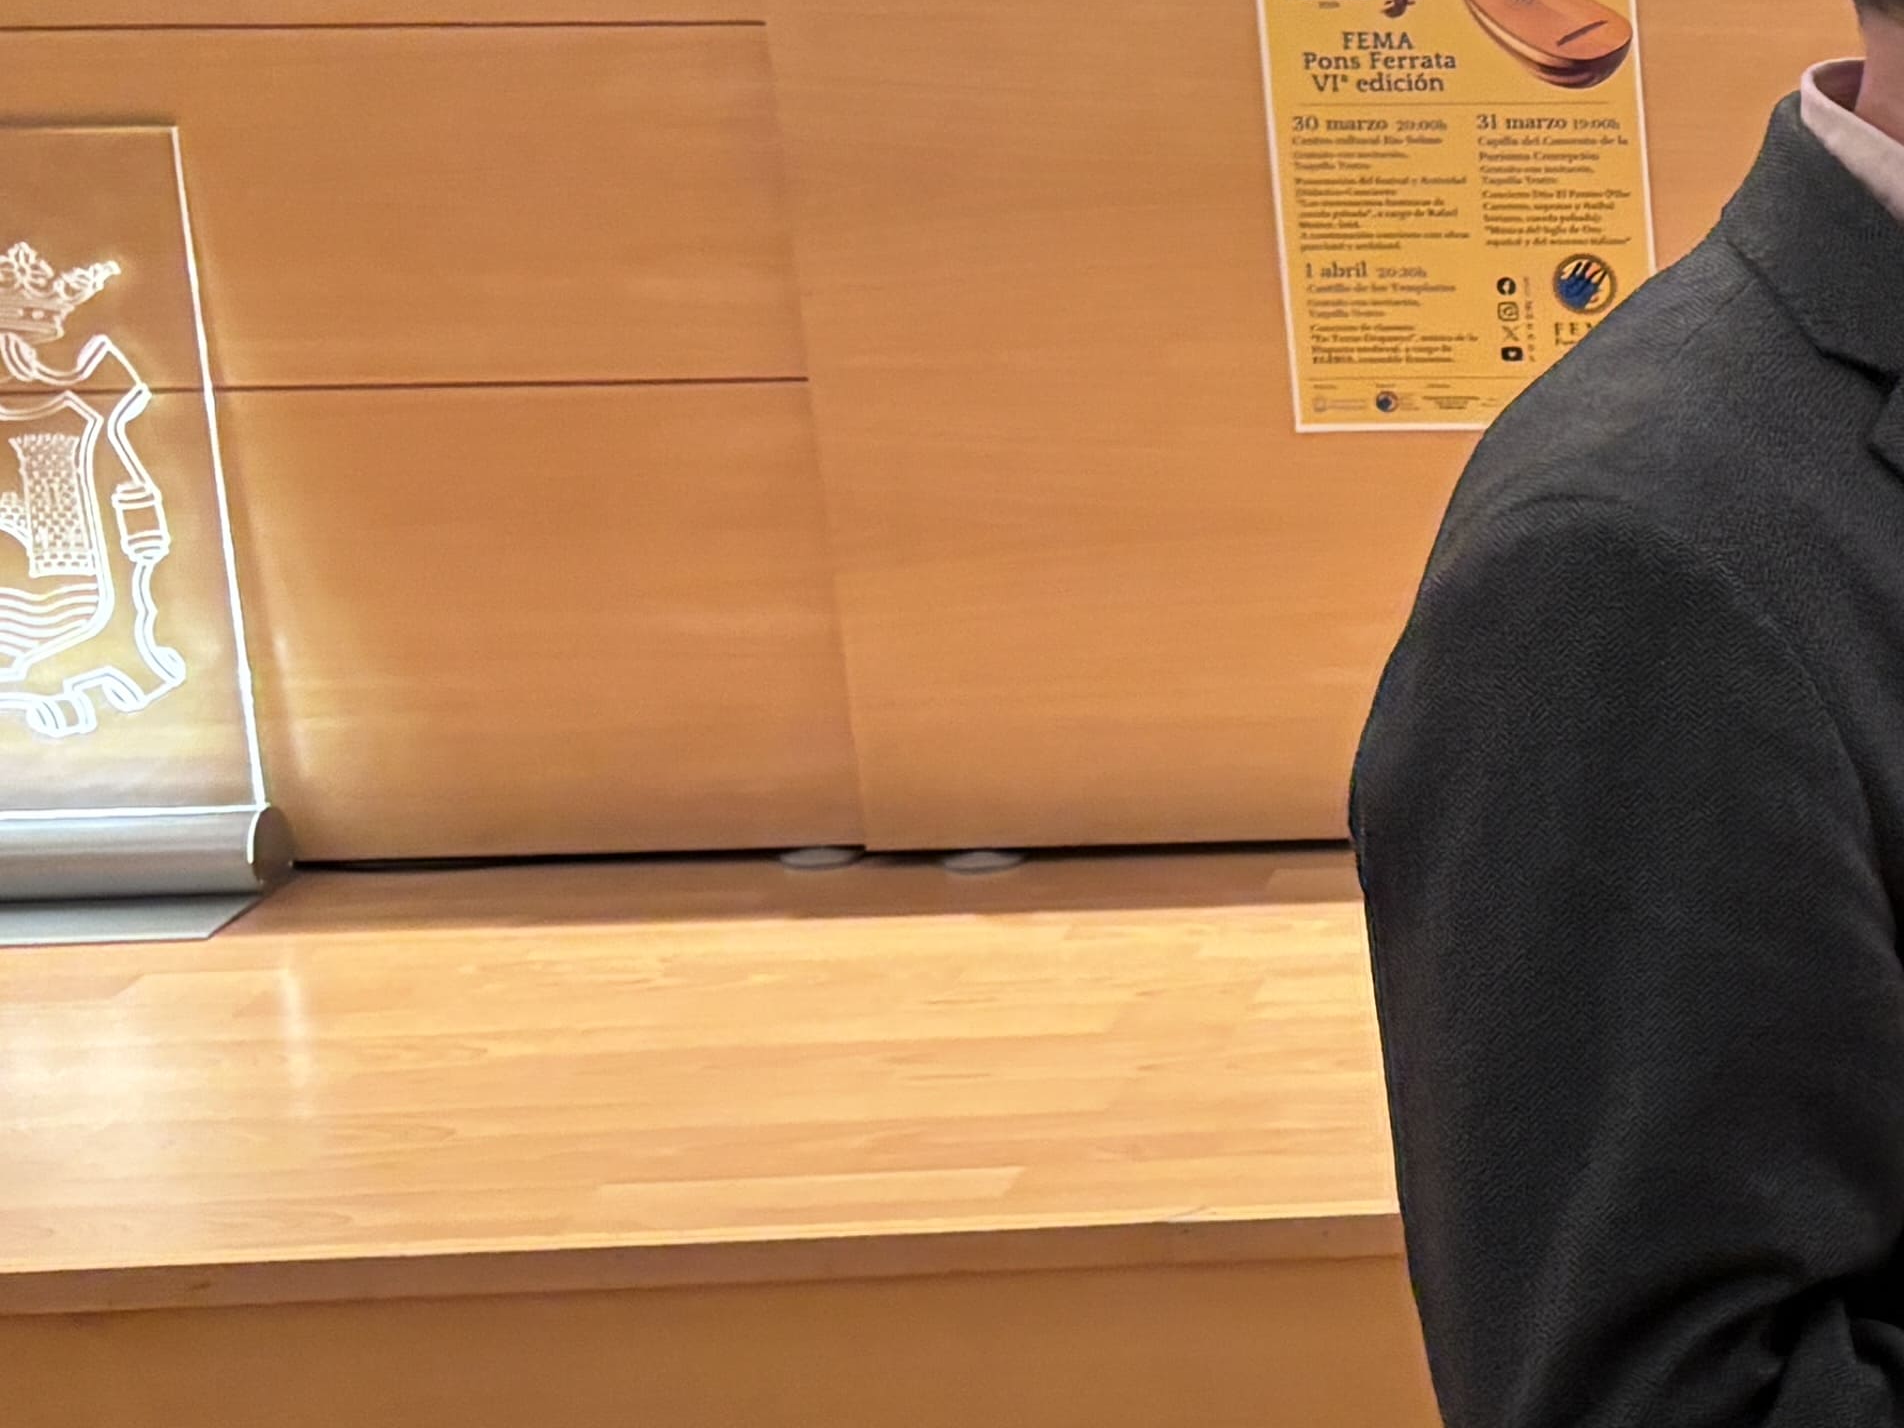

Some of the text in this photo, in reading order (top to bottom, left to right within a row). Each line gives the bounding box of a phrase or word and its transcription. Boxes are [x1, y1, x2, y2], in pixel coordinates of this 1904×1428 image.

[1341, 31, 1414, 51] FEMA
[1303, 51, 1457, 70] Pons Ferrata
[1355, 71, 1444, 93] edición
[1292, 115, 1389, 132] 30 marzo
[1476, 113, 1567, 130] 31 marzo
[1320, 260, 1368, 279] abril
